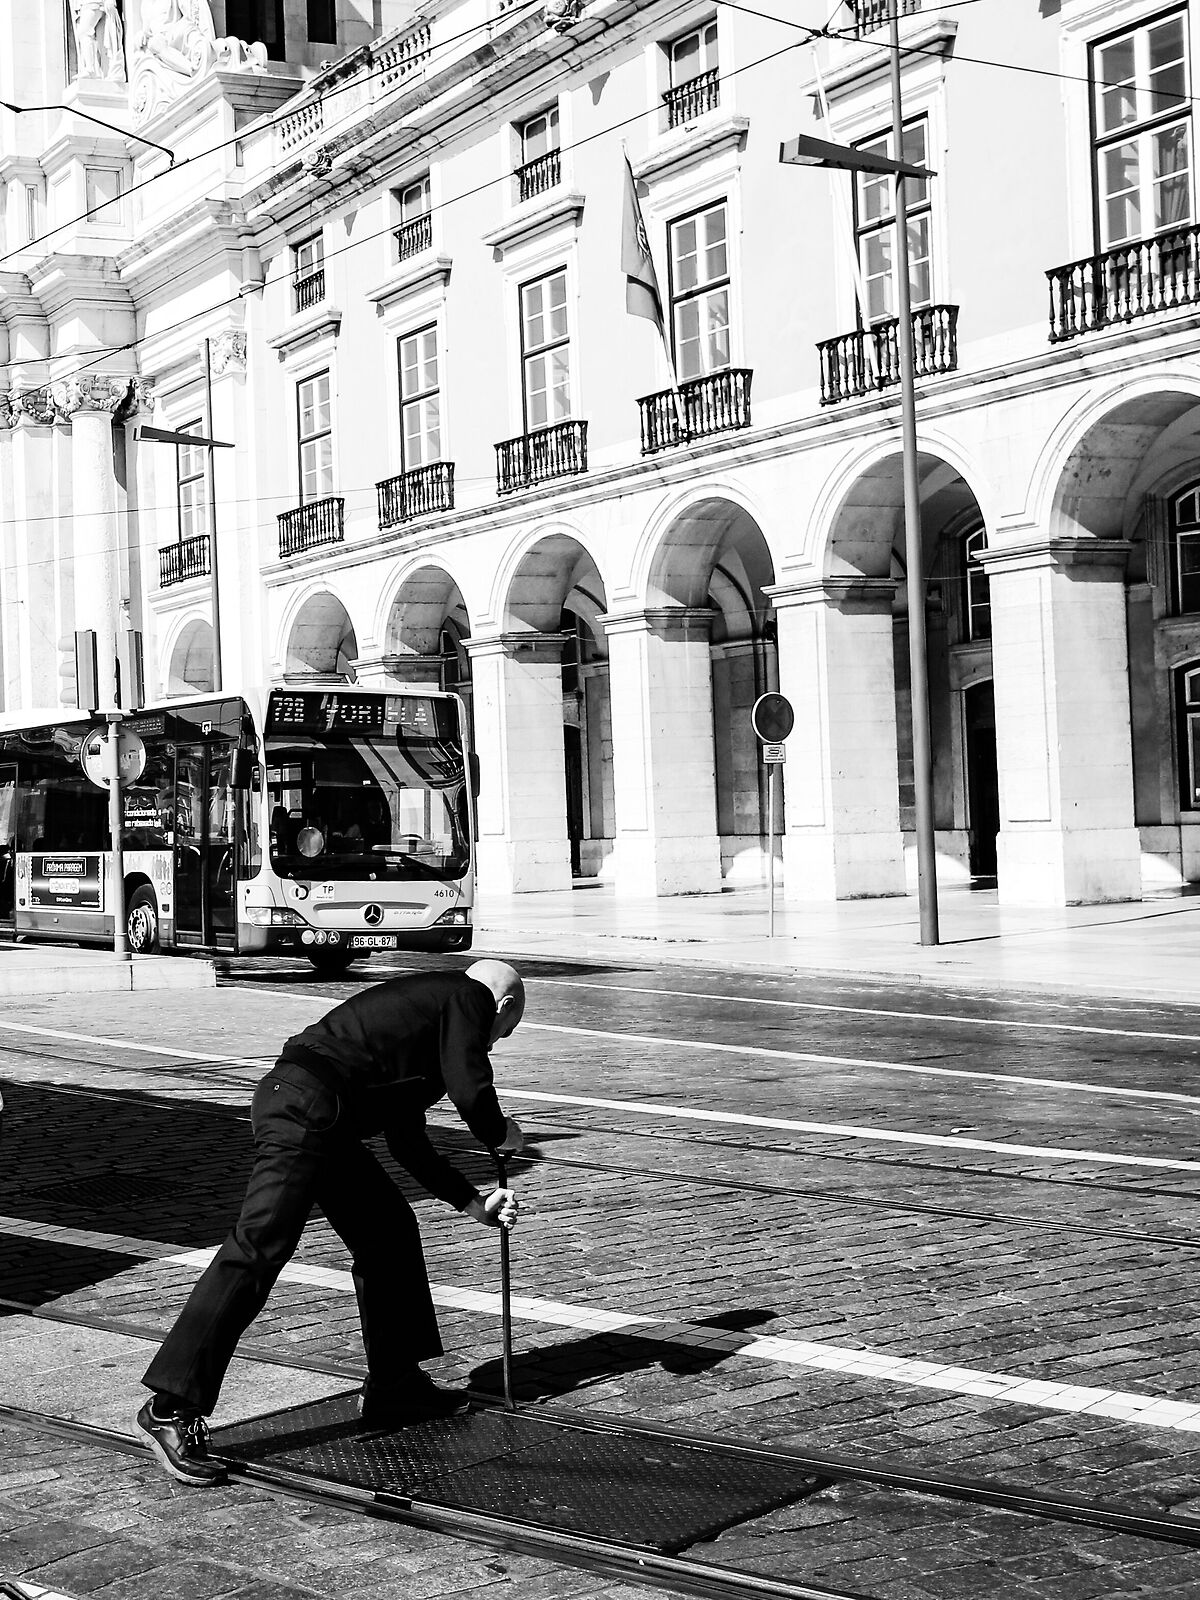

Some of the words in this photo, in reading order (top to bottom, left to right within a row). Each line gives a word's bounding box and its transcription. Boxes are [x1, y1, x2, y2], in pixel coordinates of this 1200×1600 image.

[322, 885, 334, 895] TP
[434, 888, 455, 898] 4610
[353, 936, 392, 947] 96-GL-87
